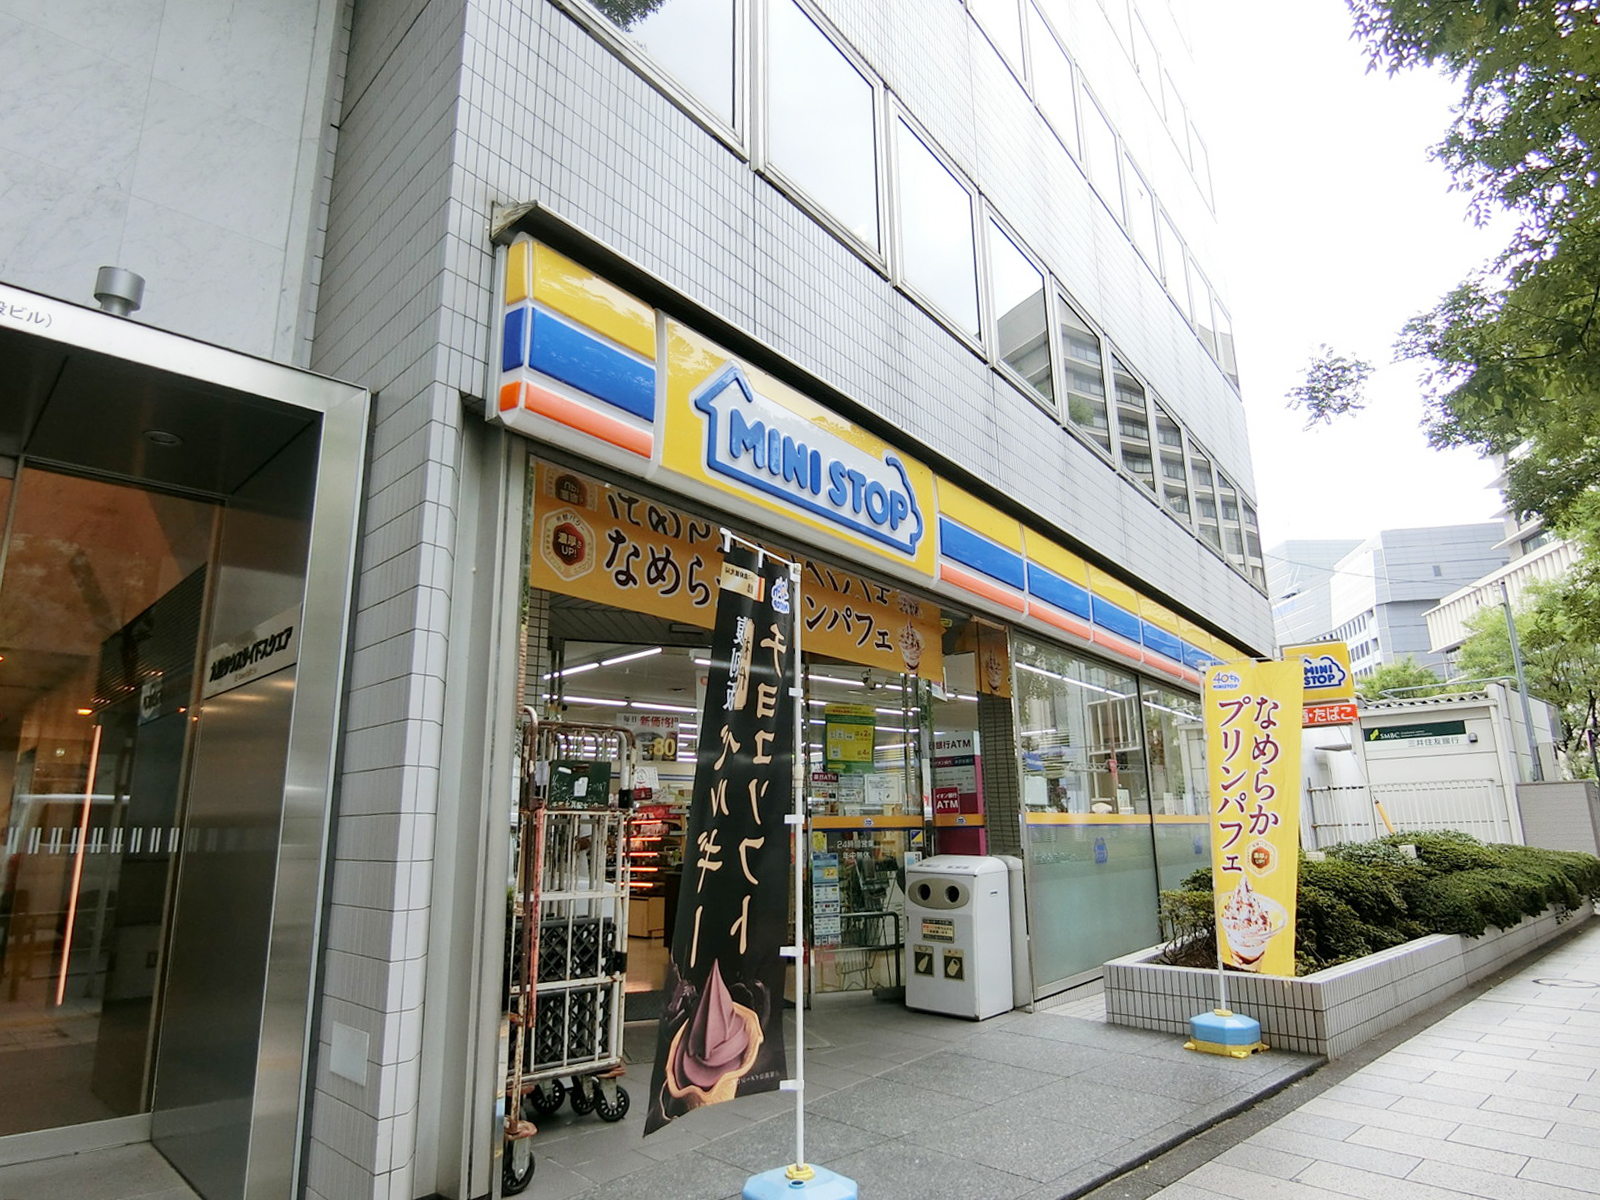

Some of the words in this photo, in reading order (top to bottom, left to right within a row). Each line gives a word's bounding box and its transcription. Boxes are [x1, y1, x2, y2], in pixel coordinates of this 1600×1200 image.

[730, 409, 821, 496] MINI
[828, 461, 908, 531] STOP
[561, 545, 577, 558] UP!
[1304, 664, 1333, 676] MINI
[1304, 675, 1335, 686] STOP
[1380, 732, 1400, 740] SMBC
[1408, 736, 1460, 748] 三井住友銀行
[1249, 697, 1279, 835] なめらか
[1217, 696, 1252, 872] プリンパフェ
[936, 800, 959, 809] ATM
